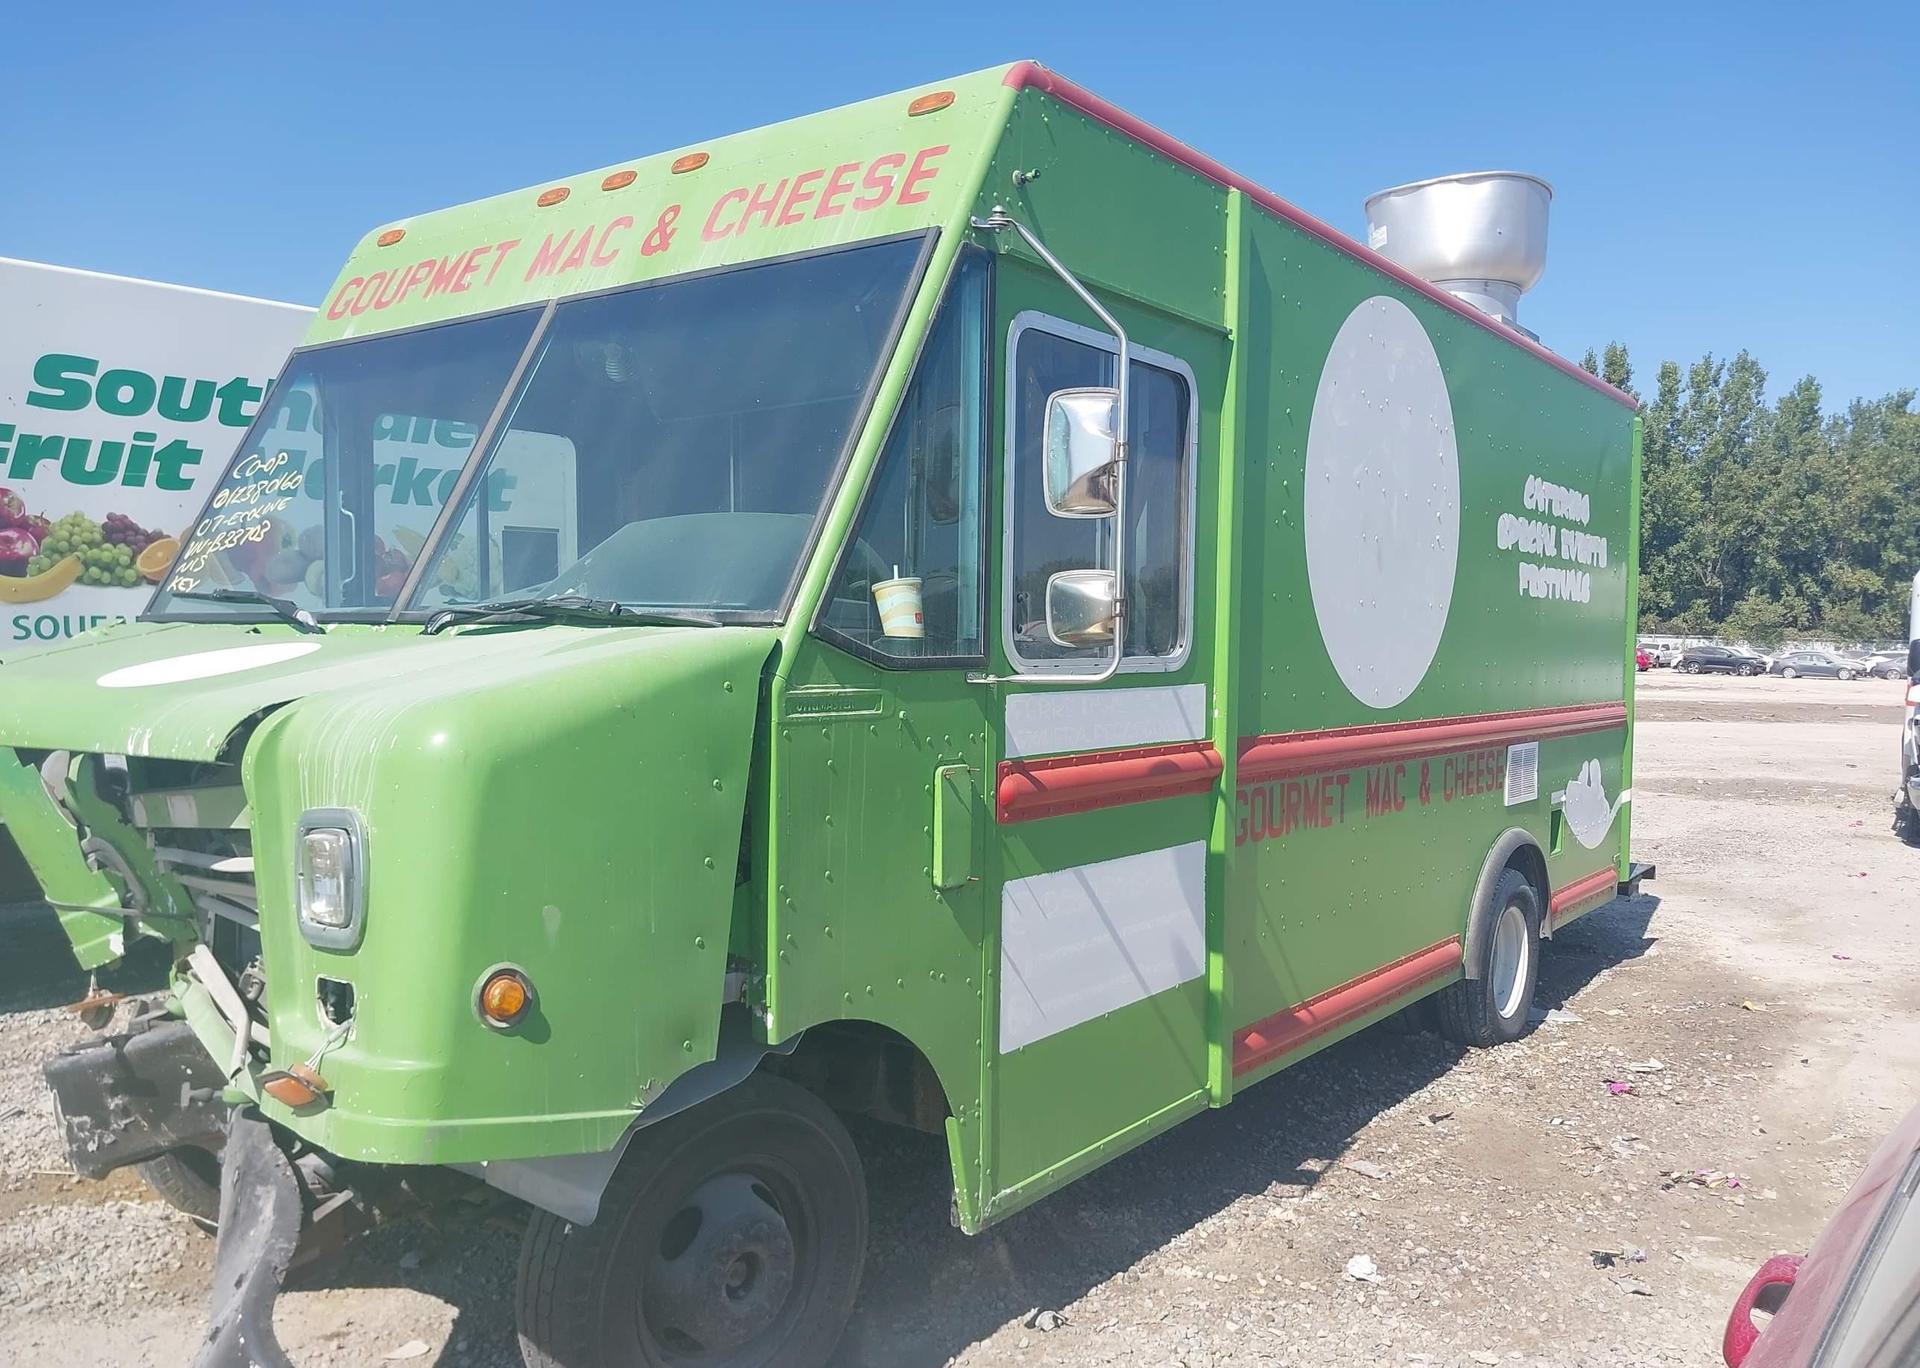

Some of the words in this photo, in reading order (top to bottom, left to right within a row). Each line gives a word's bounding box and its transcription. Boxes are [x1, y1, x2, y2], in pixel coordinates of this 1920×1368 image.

[524, 216, 633, 282] MAC
[640, 204, 681, 256] &
[701, 145, 949, 242] CHEESE
[167, 575, 200, 592] KEY
[1235, 774, 1349, 847] GOURMET
[1365, 763, 1406, 818] MAC
[1419, 760, 1430, 805] &
[1444, 748, 1504, 802] CHEESE
